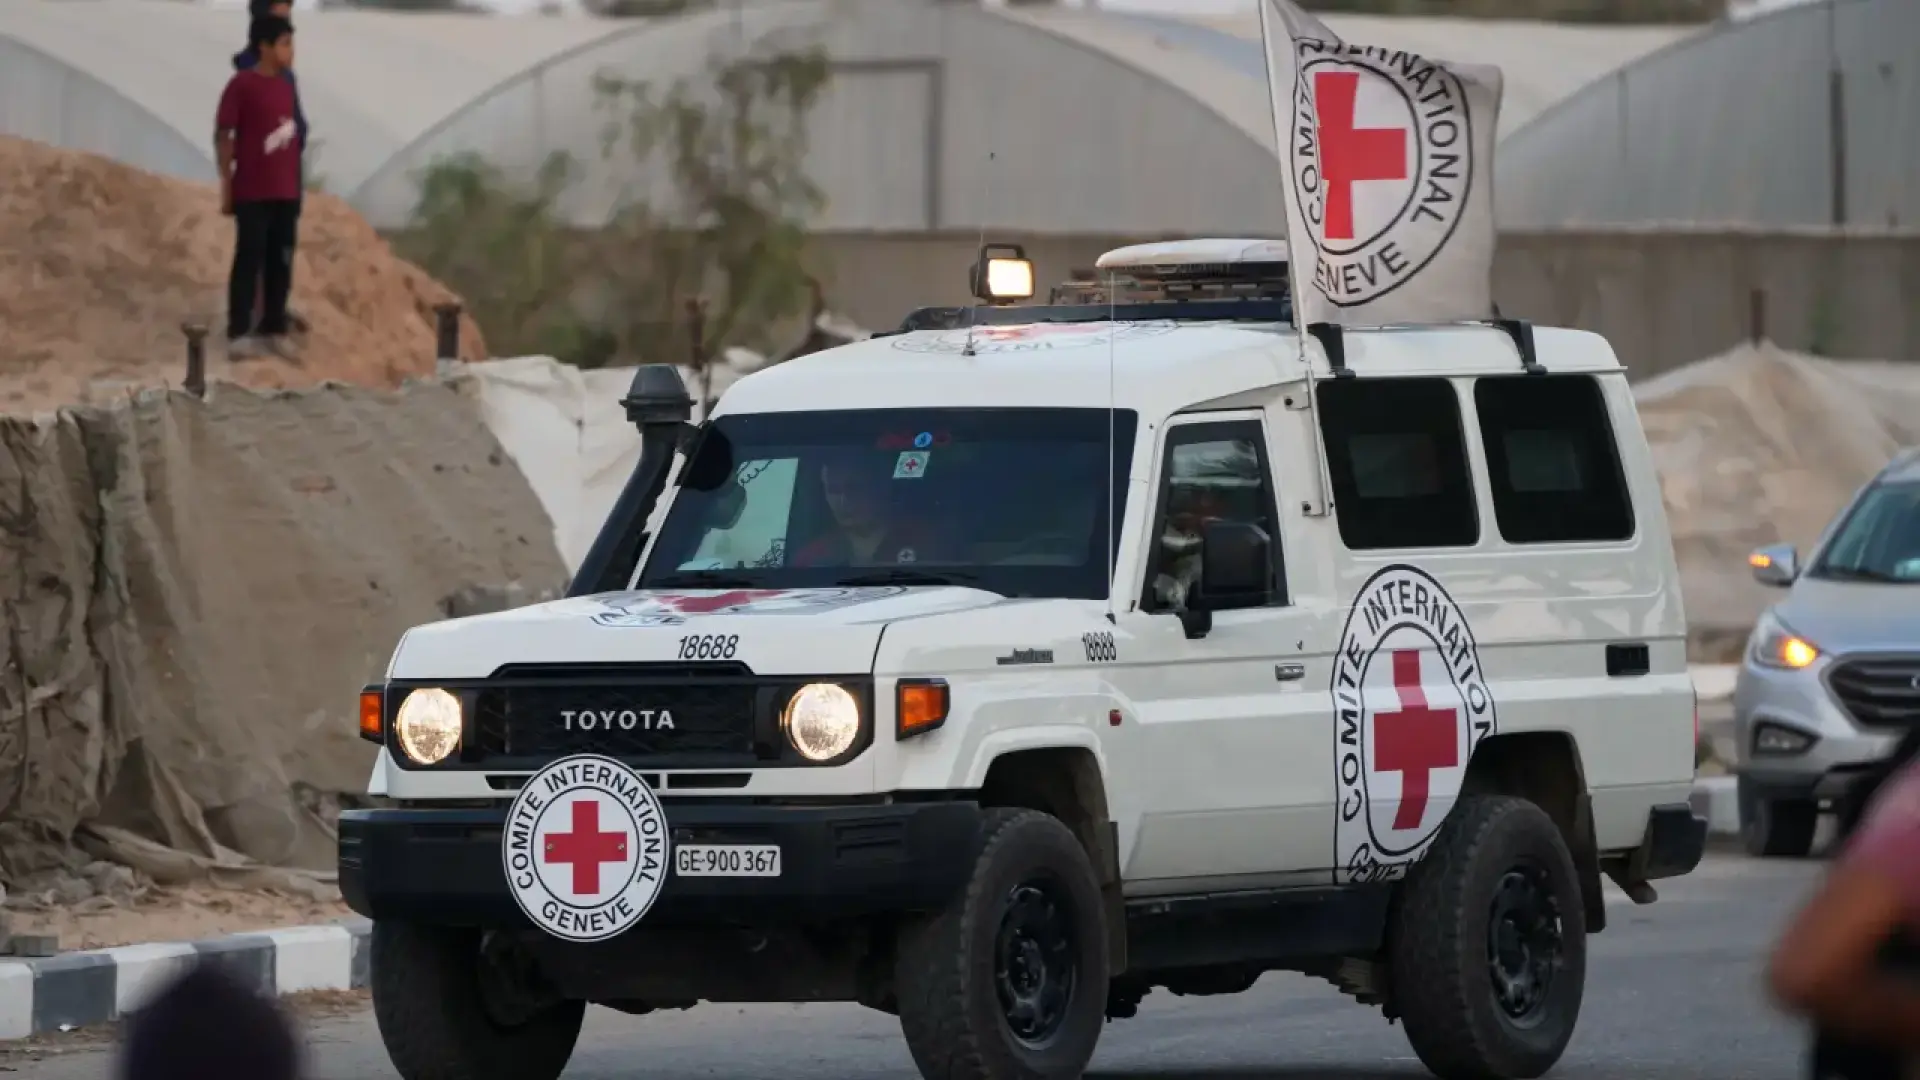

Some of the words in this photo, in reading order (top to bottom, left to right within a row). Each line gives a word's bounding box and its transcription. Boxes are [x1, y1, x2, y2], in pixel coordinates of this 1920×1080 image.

[1299, 87, 1321, 225] COMIT
[1316, 241, 1409, 294] ENEVE
[678, 633, 739, 660] 18688
[1081, 631, 1117, 662] 18688
[1341, 632, 1366, 822] COMITE
[1362, 579, 1492, 740] INTERNATION
[560, 709, 675, 730] TOYOTA
[511, 791, 544, 890] COMITE
[543, 763, 661, 885] INTERNATIONAL
[743, 848, 778, 872] 367
[542, 897, 634, 933] GENEVE
